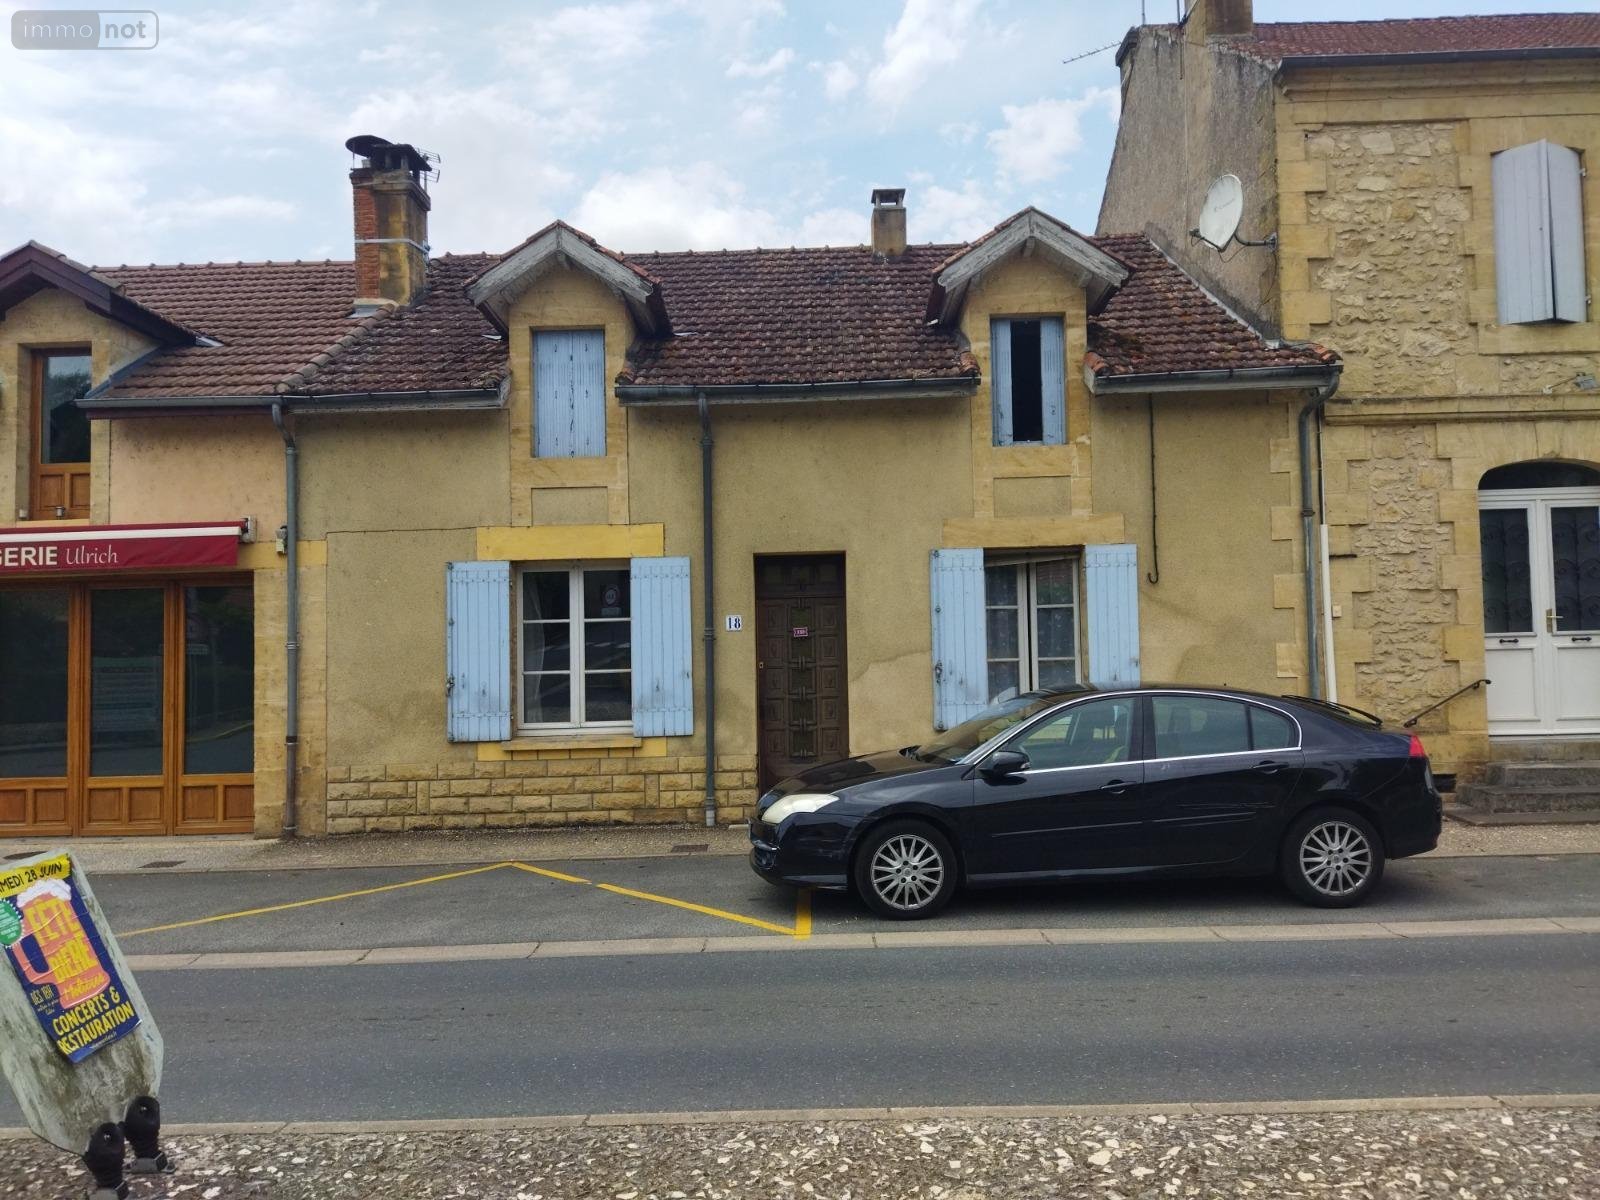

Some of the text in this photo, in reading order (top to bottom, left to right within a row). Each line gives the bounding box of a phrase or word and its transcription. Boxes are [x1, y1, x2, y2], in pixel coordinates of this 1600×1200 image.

[0, 544, 119, 567] ERIE Ulrich
[728, 616, 741, 630] 18
[0, 861, 63, 893] MEDI 28 JUIN
[52, 993, 110, 1036] CONCERTS
[109, 986, 121, 1004] &
[57, 1000, 135, 1055] RESTAURATION
